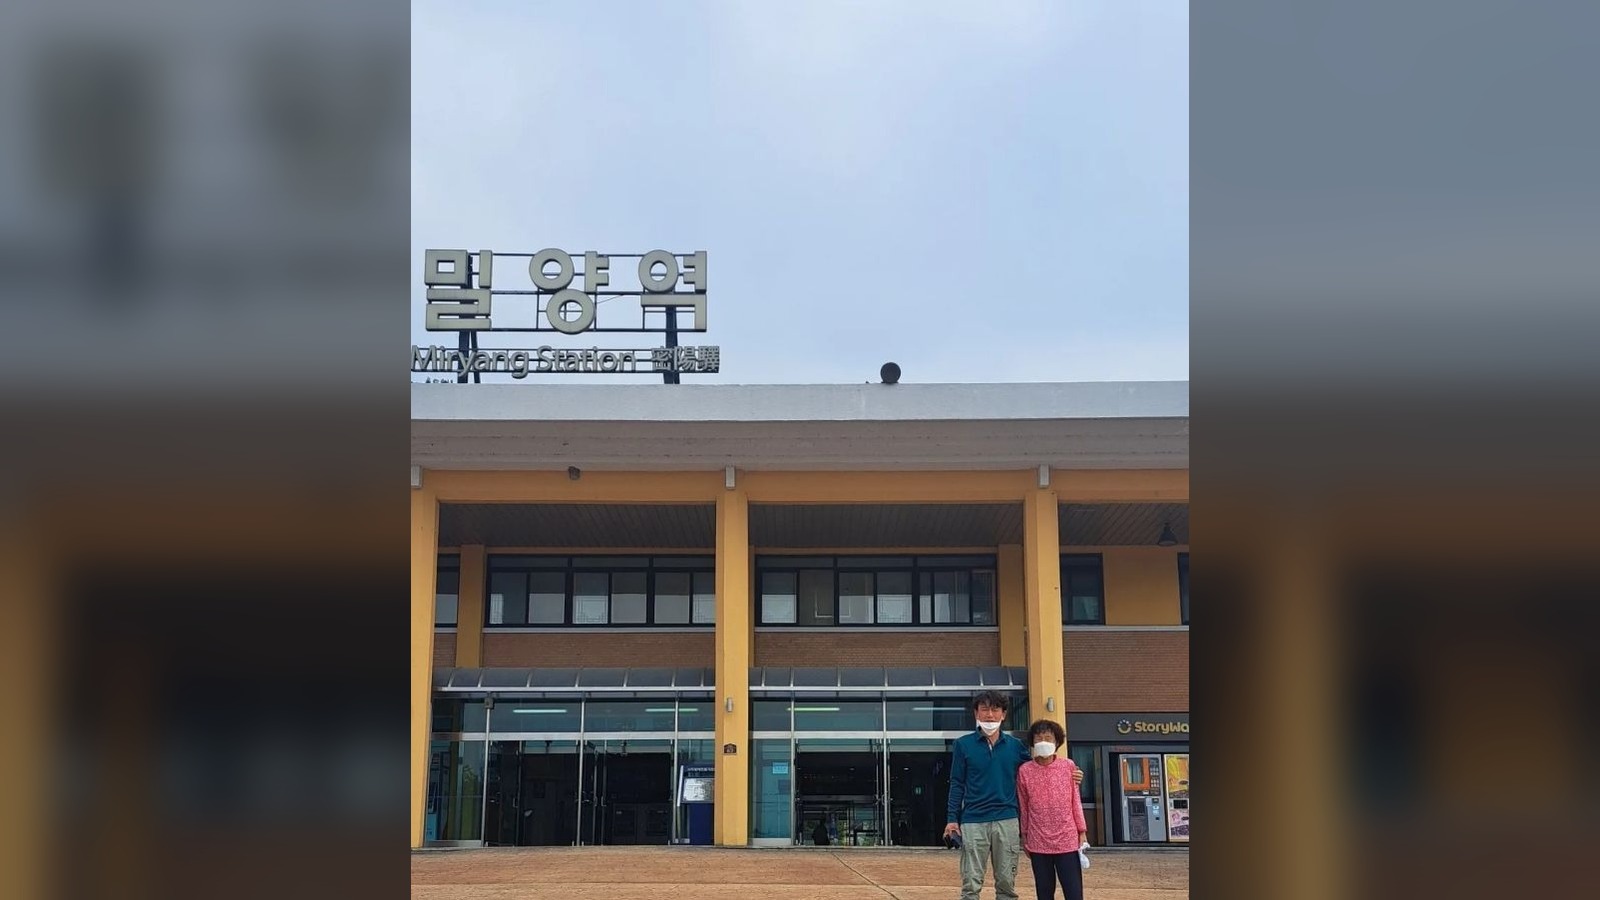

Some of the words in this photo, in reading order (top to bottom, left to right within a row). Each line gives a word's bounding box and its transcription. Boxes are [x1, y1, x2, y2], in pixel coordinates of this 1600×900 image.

[425, 248, 707, 334] 밀양역
[411, 345, 529, 378] Miryang
[536, 345, 636, 372] Station
